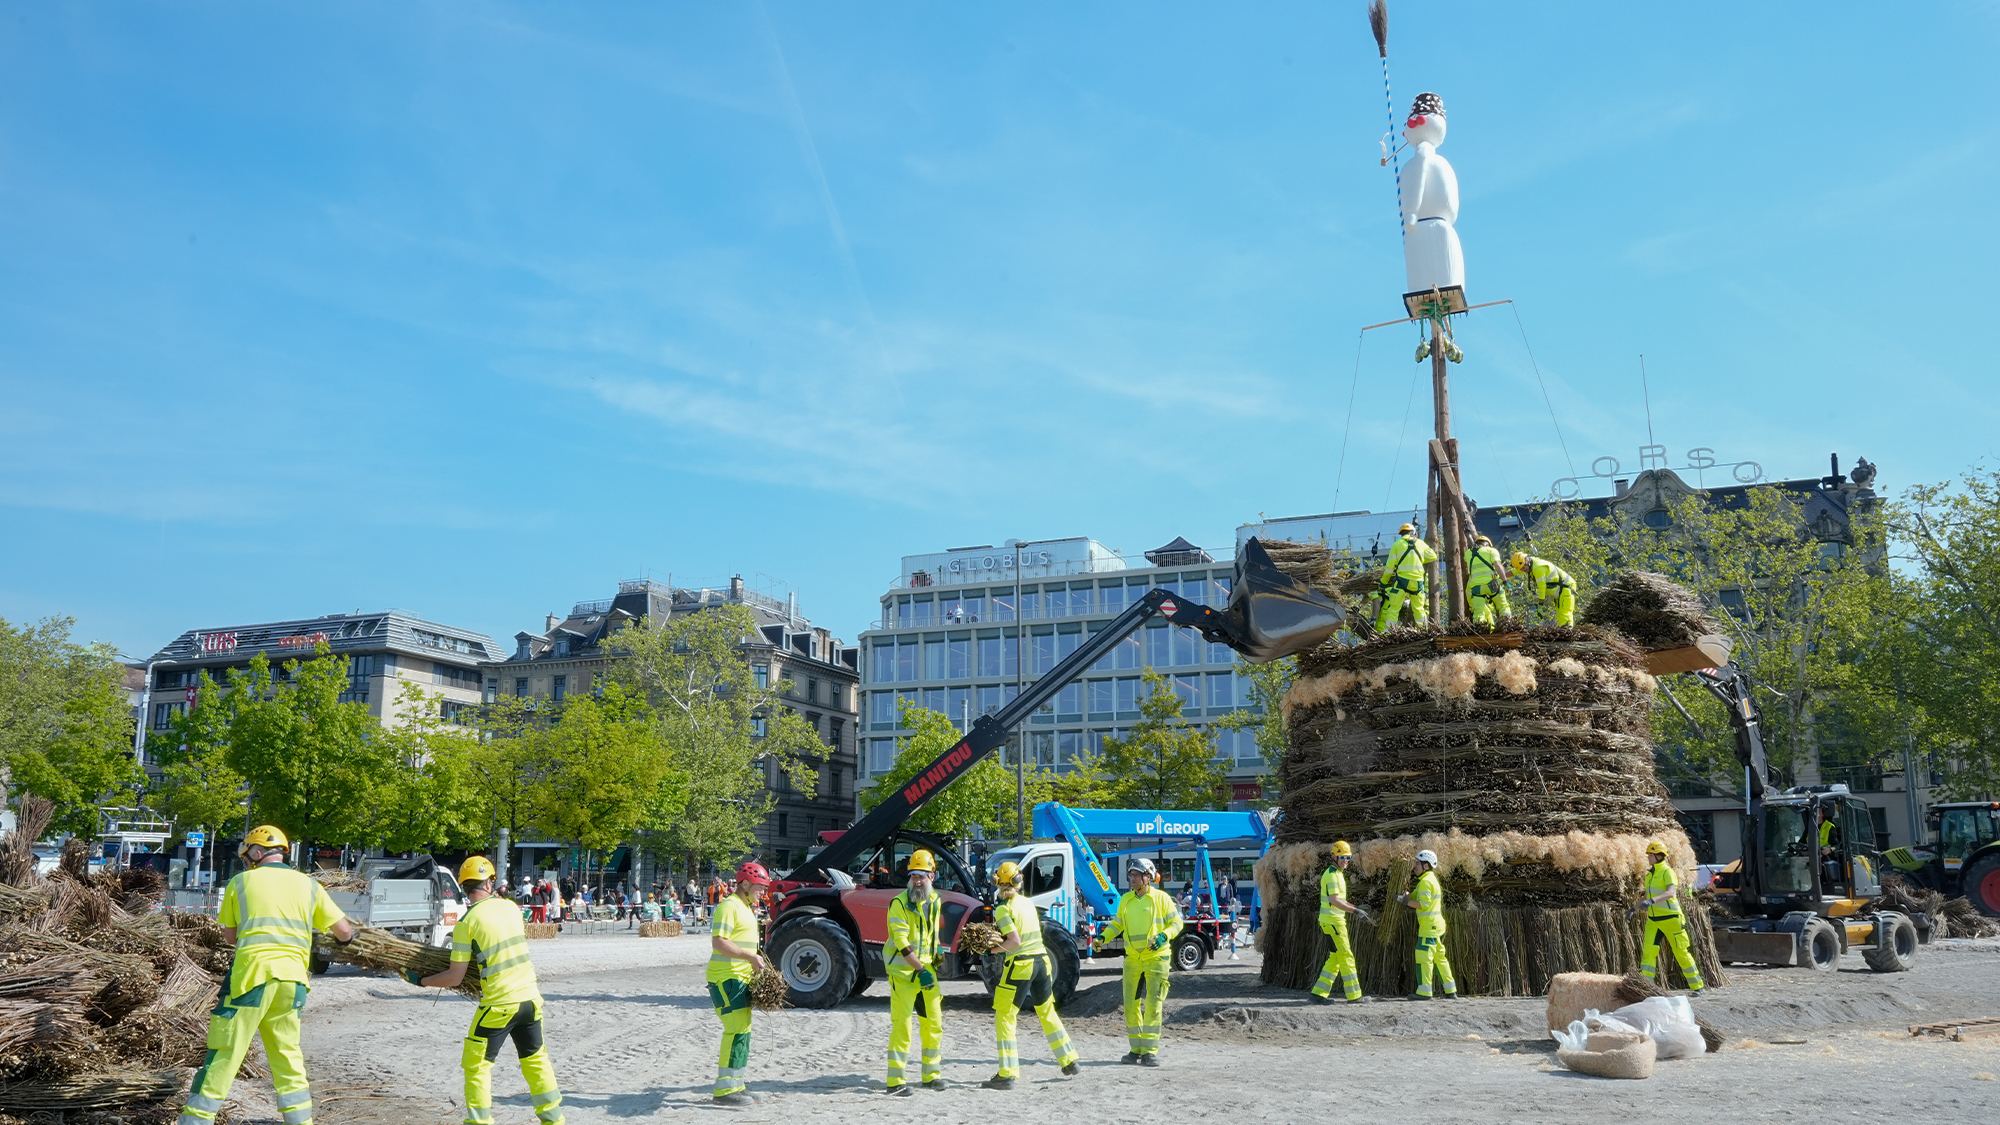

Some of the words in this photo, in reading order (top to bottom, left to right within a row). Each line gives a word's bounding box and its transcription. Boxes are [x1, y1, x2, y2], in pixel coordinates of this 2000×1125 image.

[1551, 444, 1763, 499] CORSO
[948, 551, 1049, 573] GLOBUS
[206, 632, 237, 651] UBS
[279, 635, 306, 647] coop
[309, 632, 329, 645] city
[903, 742, 972, 805] MANITOU
[1233, 788, 1261, 796] FITNESS
[1136, 822, 1155, 834] UP
[1163, 823, 1210, 835] GROUP
[1090, 862, 1109, 890] PALFINGER
